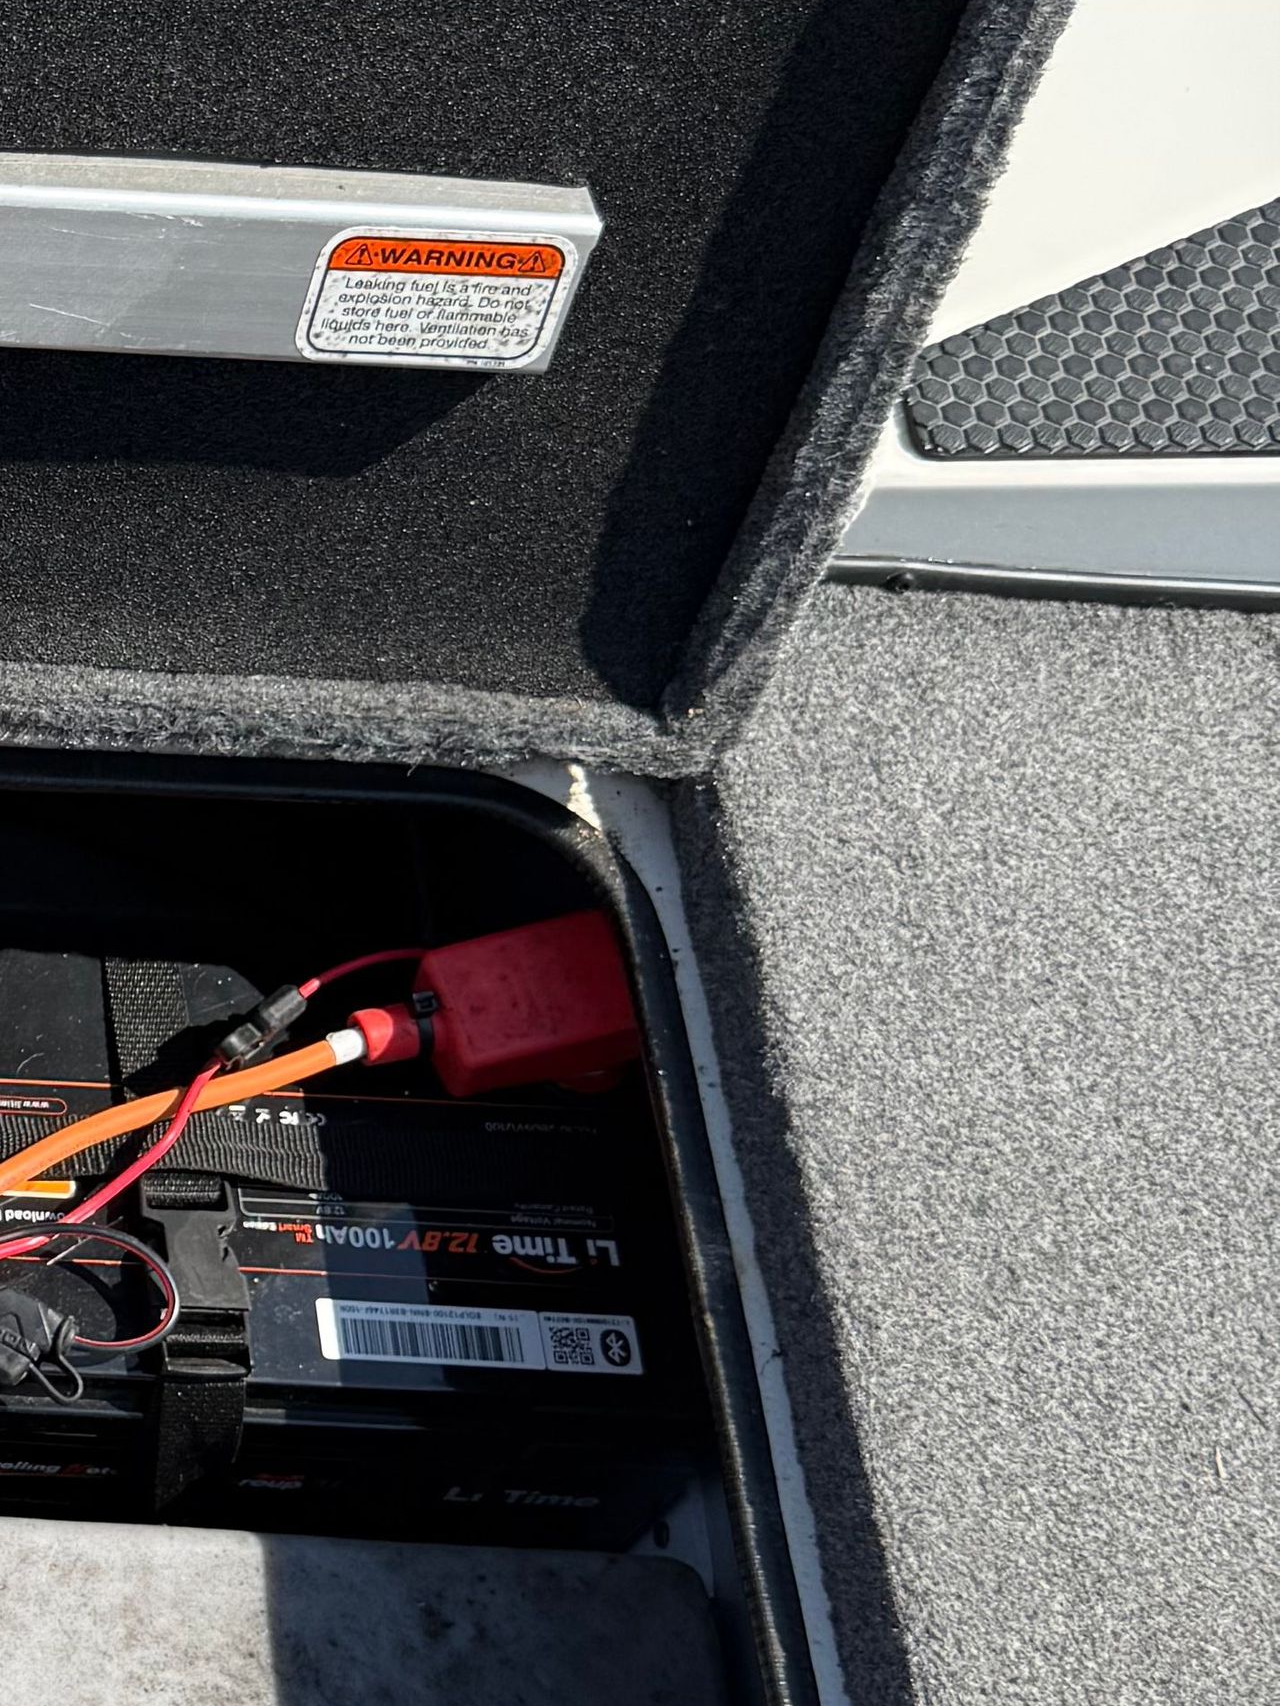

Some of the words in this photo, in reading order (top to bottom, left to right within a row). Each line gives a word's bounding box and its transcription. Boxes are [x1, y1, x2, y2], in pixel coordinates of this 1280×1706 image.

[379, 247, 517, 272] WARNING
[345, 278, 405, 294] Leaking
[410, 281, 439, 294] fuel
[459, 285, 468, 294] a
[472, 283, 500, 295] fire
[501, 284, 531, 297] and
[339, 293, 411, 306] explosion
[416, 295, 472, 308] hazard.
[478, 296, 502, 309] Do
[503, 298, 530, 311] not
[341, 306, 379, 318] store
[384, 307, 413, 320] fuel
[417, 310, 434, 320] or
[436, 309, 517, 324] flammable
[320, 318, 371, 334] liquids
[420, 323, 498, 337] Ventilation
[500, 325, 529, 339] has
[348, 334, 374, 346] not
[377, 335, 416, 348] been
[278, 1222, 314, 1236] Smart
[509, 1213, 552, 1228] Voltage
[552, 1215, 598, 1230] Nominal
[295, 1232, 315, 1245] TM
[315, 1223, 396, 1250] 100Ah
[397, 1228, 481, 1254] 12.8V
[490, 1233, 582, 1267] Time
[588, 1237, 622, 1268] Li
[237, 1475, 305, 1491] roup
[441, 1484, 484, 1502] Li
[502, 1487, 601, 1508] Time
